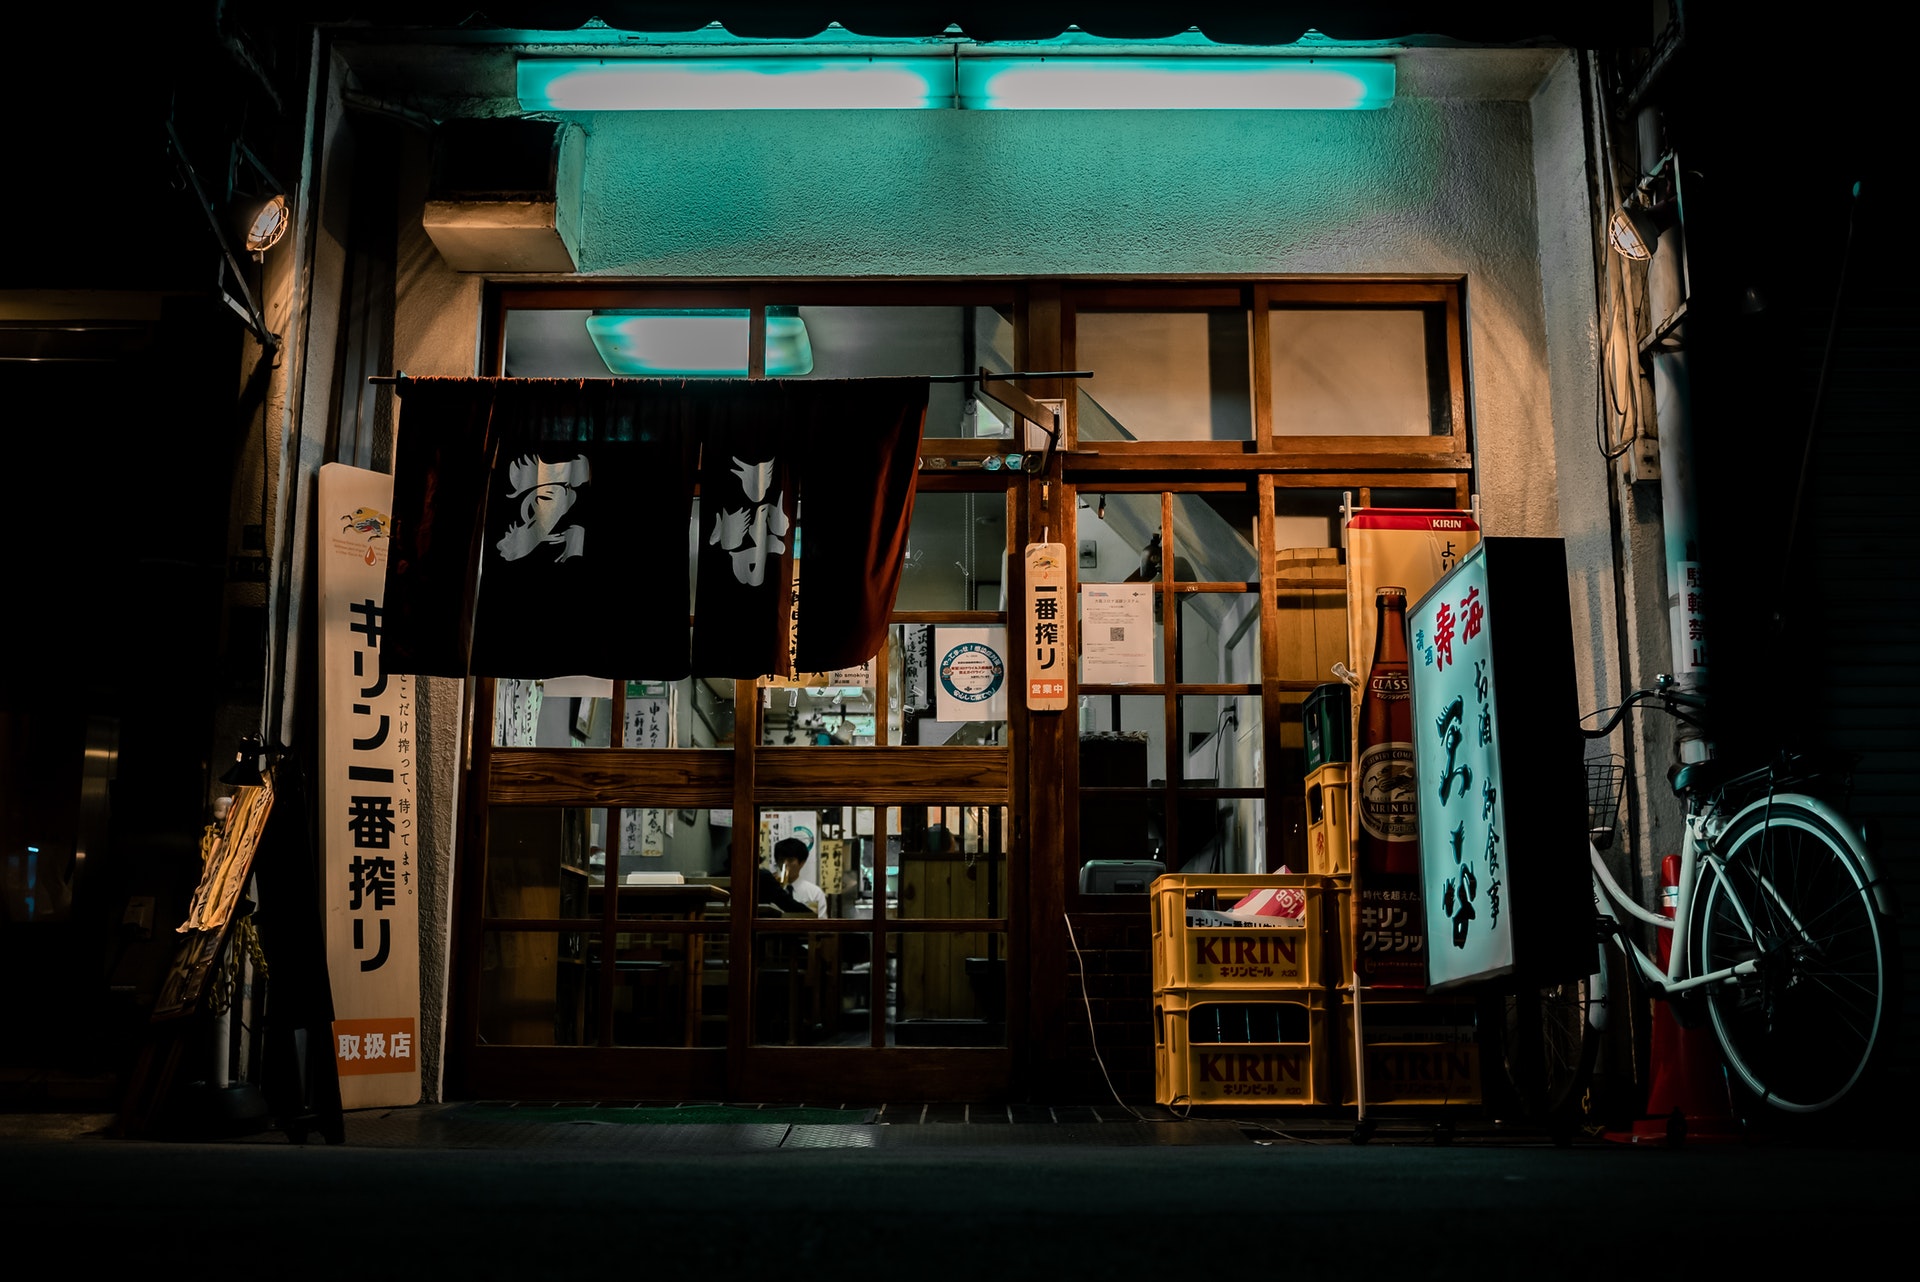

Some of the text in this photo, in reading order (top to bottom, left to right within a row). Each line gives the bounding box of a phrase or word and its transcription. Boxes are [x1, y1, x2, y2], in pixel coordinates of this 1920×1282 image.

[1432, 519, 1462, 529] KIRIN
[1035, 585, 1058, 670] 一番搾り
[1031, 683, 1064, 694] 営業中
[1372, 679, 1409, 690] CLASS
[634, 711, 645, 746] 二軒目の
[1392, 750, 1414, 760] COMP
[349, 599, 397, 972] キリン一番搾り
[1370, 803, 1415, 813] KIRIN BE
[1361, 907, 1408, 928] キリン
[1196, 936, 1297, 965] KIRIN
[1362, 931, 1424, 953] クラシッ
[1220, 966, 1274, 977] キリンビール
[337, 1032, 412, 1061] 取扱店
[1199, 1053, 1301, 1082] KIRIN
[1371, 1051, 1471, 1081] KIRIN
[1224, 1084, 1278, 1095] キリンビール
